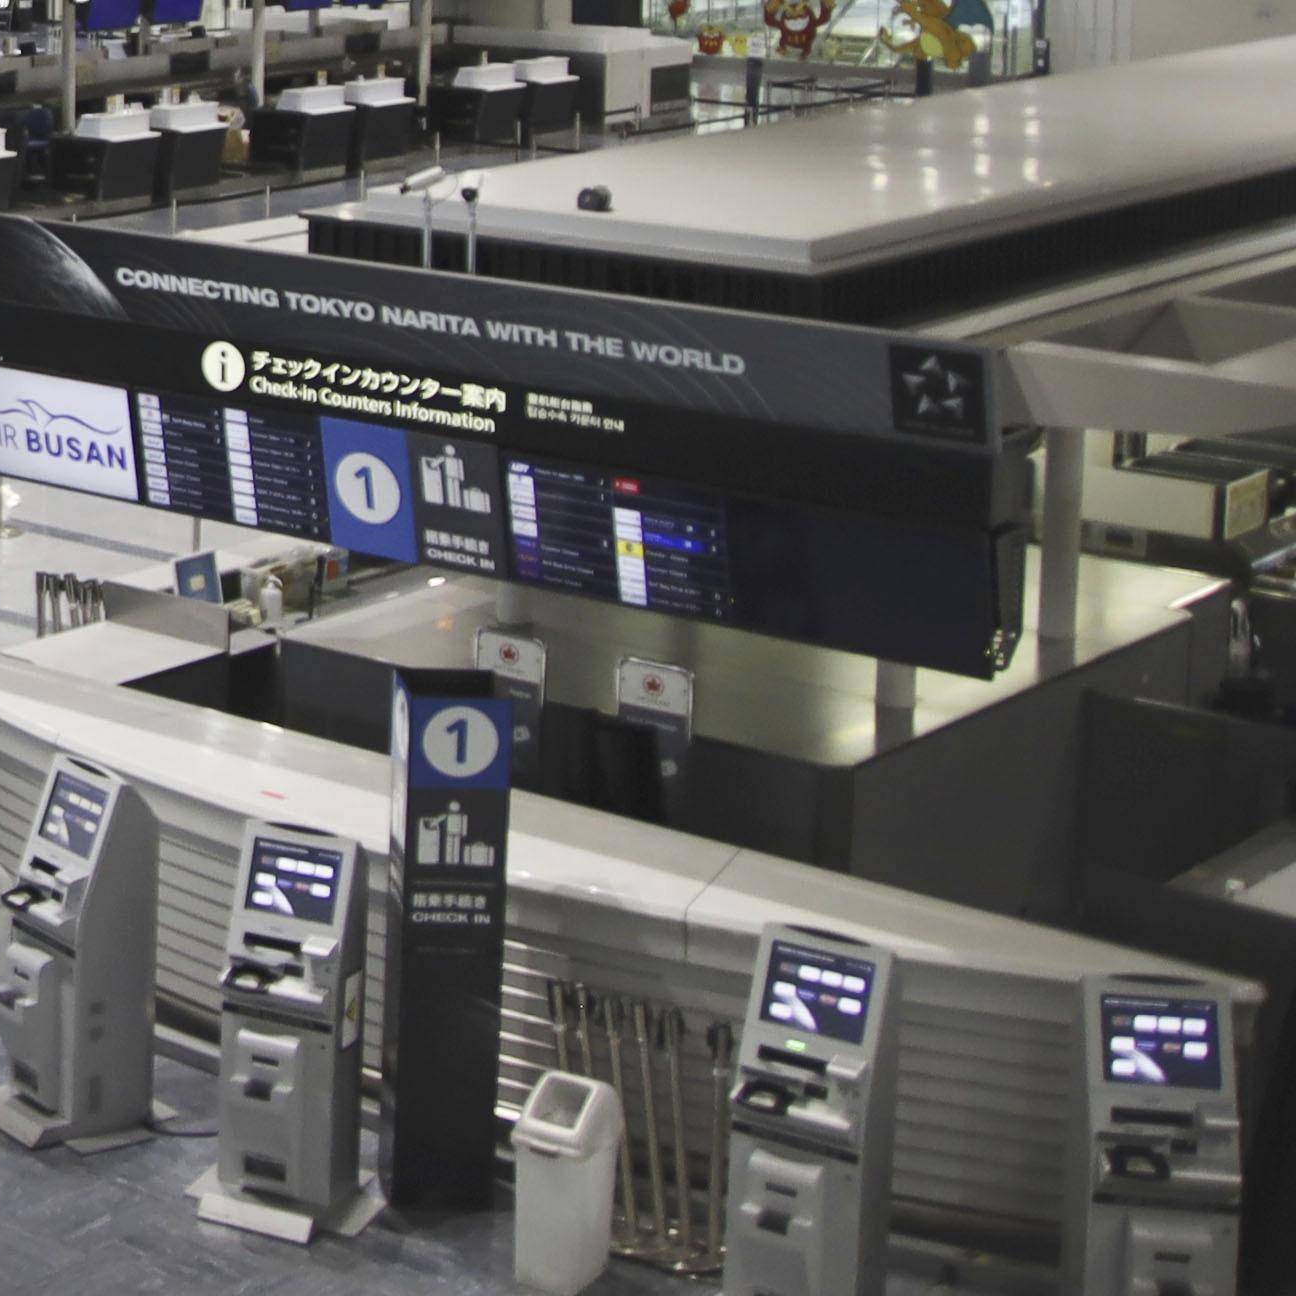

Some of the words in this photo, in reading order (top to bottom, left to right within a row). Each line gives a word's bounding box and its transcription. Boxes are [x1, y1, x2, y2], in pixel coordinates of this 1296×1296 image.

[115, 267, 280, 308] CONNECTING
[284, 290, 376, 323] TOKYO
[380, 306, 481, 338] NARITA
[484, 320, 558, 347] WITH
[564, 330, 625, 358] THE
[630, 340, 746, 375] WORLD
[248, 375, 318, 403] Check-in
[319, 386, 393, 416] Counters
[393, 399, 496, 433] Information
[250, 349, 507, 413] チェックインカウンター案内
[25, 428, 128, 471] BUSAN
[354, 465, 376, 511] 1
[426, 547, 478, 567] CHECK
[479, 559, 496, 571] IN
[445, 718, 469, 765] 1
[411, 911, 469, 924] CHECK
[473, 912, 491, 925] IN
